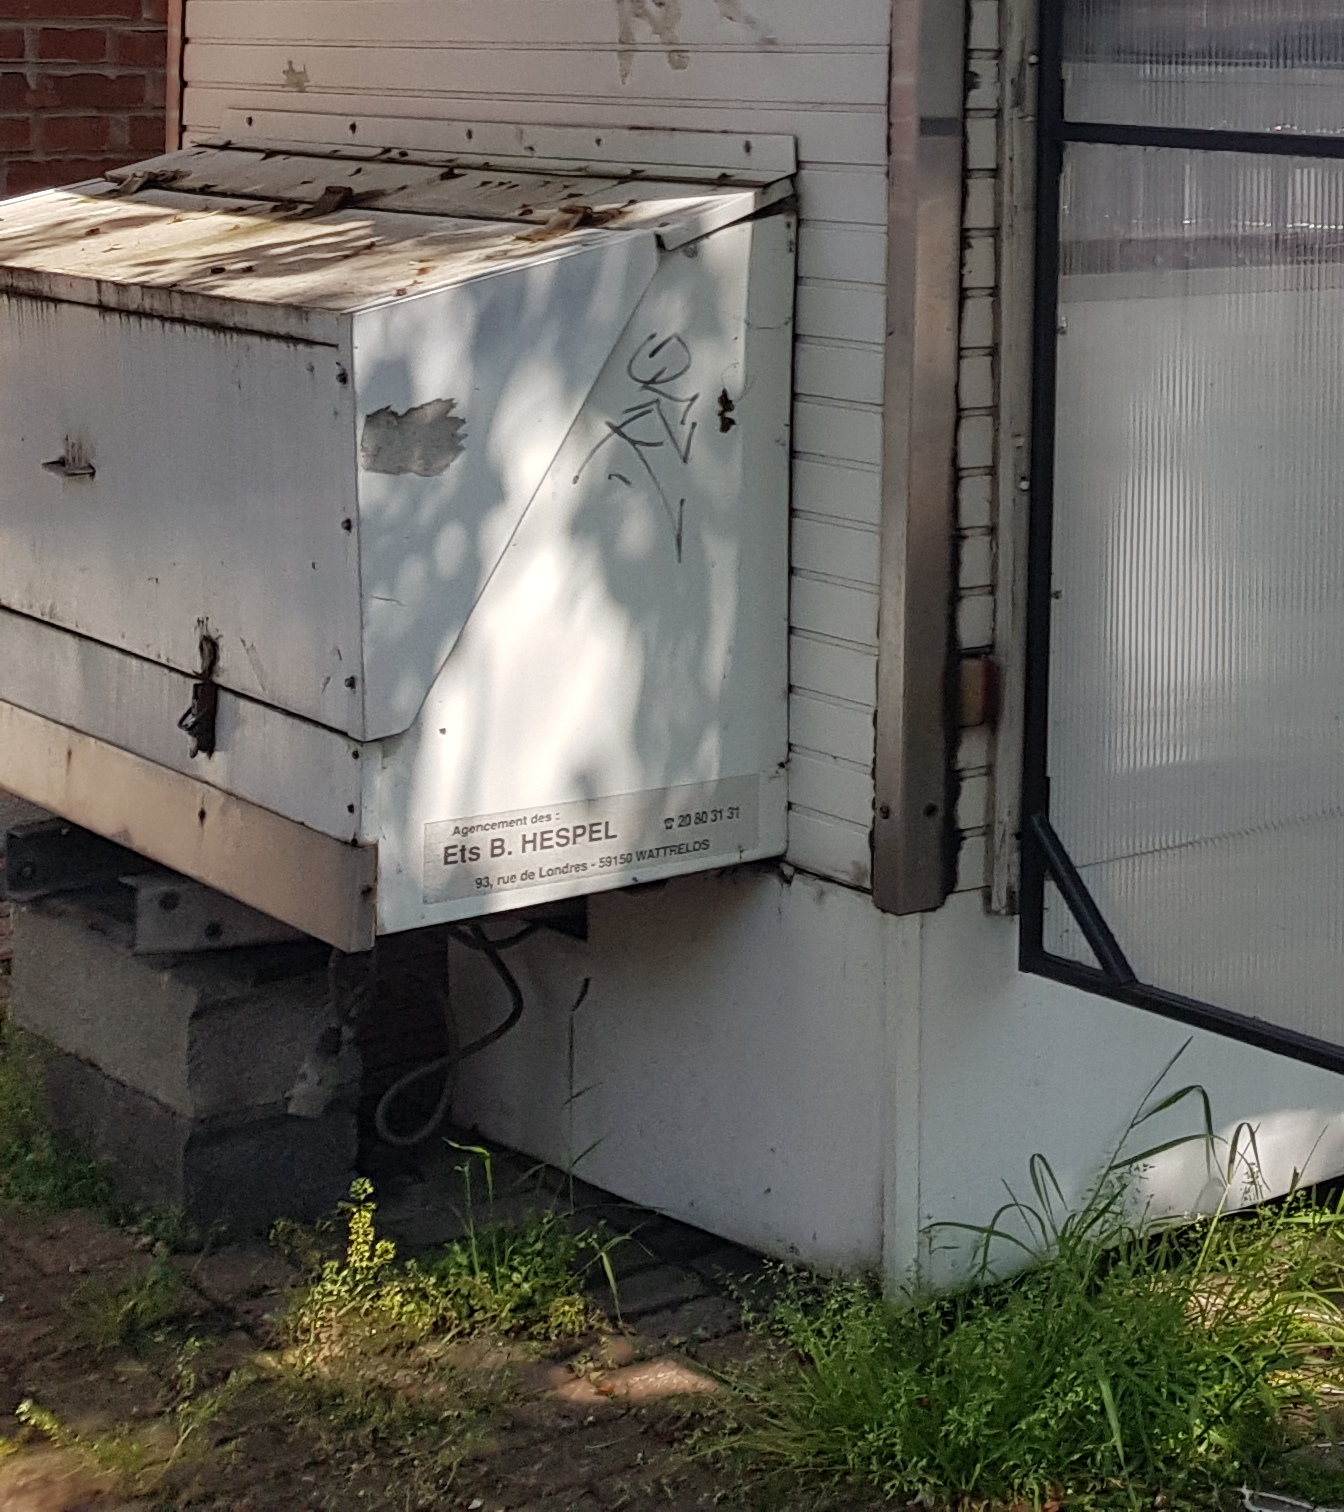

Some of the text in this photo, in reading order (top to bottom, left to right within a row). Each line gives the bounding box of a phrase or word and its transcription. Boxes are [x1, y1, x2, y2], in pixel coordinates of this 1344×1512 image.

[442, 820, 618, 866] Ets B. HESPEL
[451, 813, 528, 837] Agencement
[530, 811, 552, 825] des
[474, 875, 494, 890] 93,
[496, 872, 517, 886] rue
[519, 868, 535, 883] de
[538, 859, 588, 879] Londres
[598, 852, 634, 870] 59150
